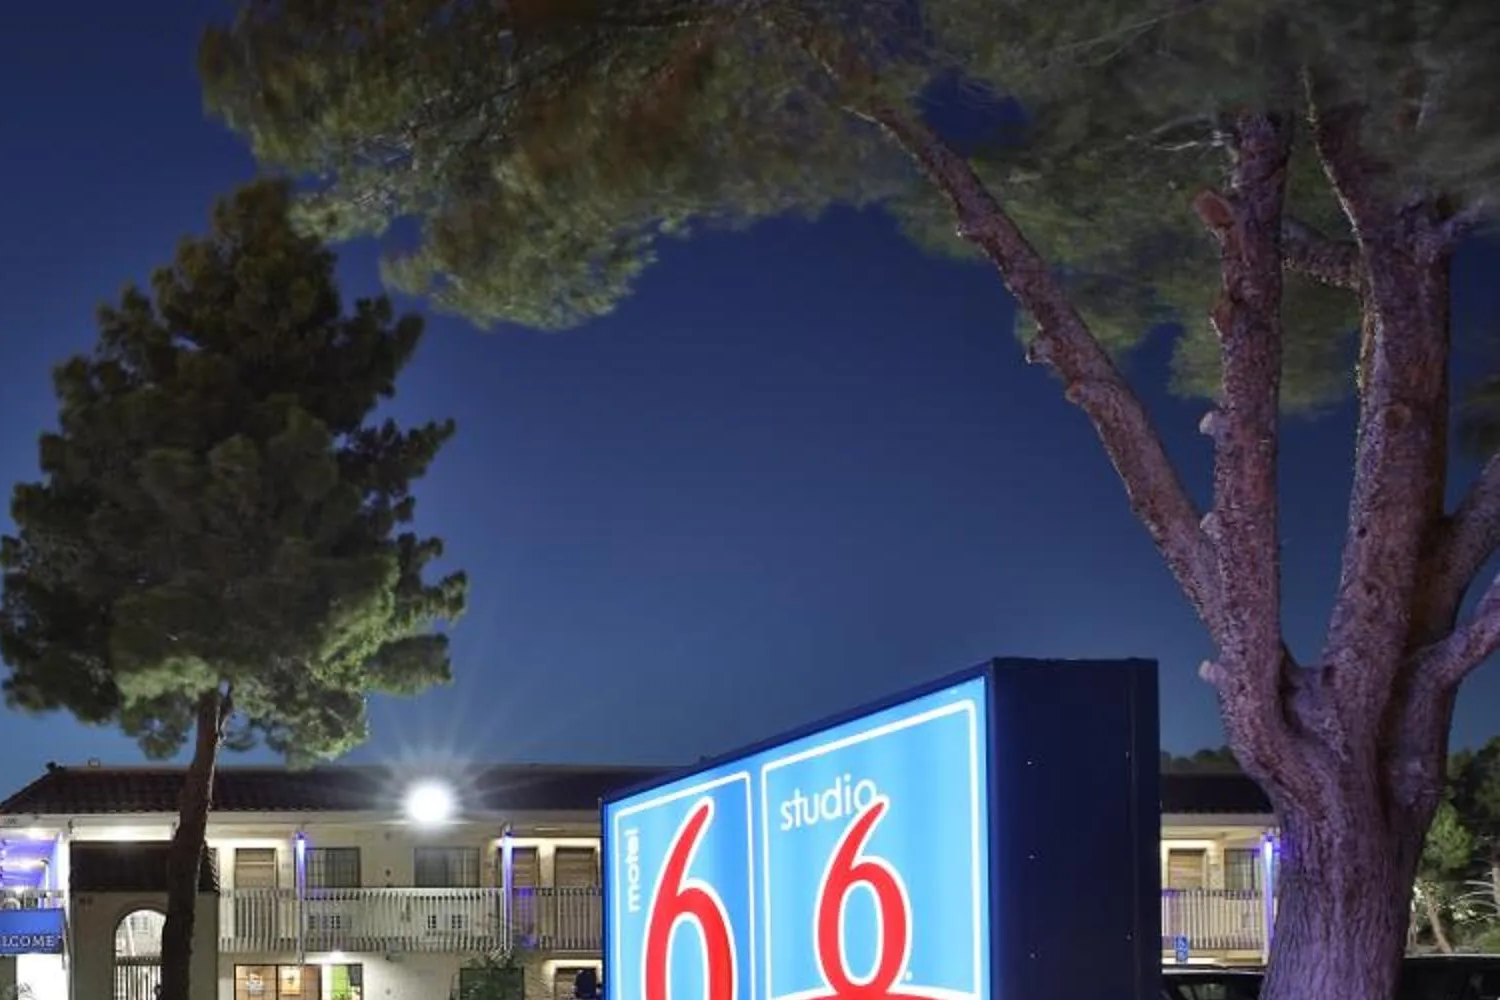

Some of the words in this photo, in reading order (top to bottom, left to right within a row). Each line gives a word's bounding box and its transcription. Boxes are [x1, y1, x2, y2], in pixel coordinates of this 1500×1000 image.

[780, 773, 877, 831] studio
[624, 828, 641, 914] motel
[814, 795, 912, 996] 6
